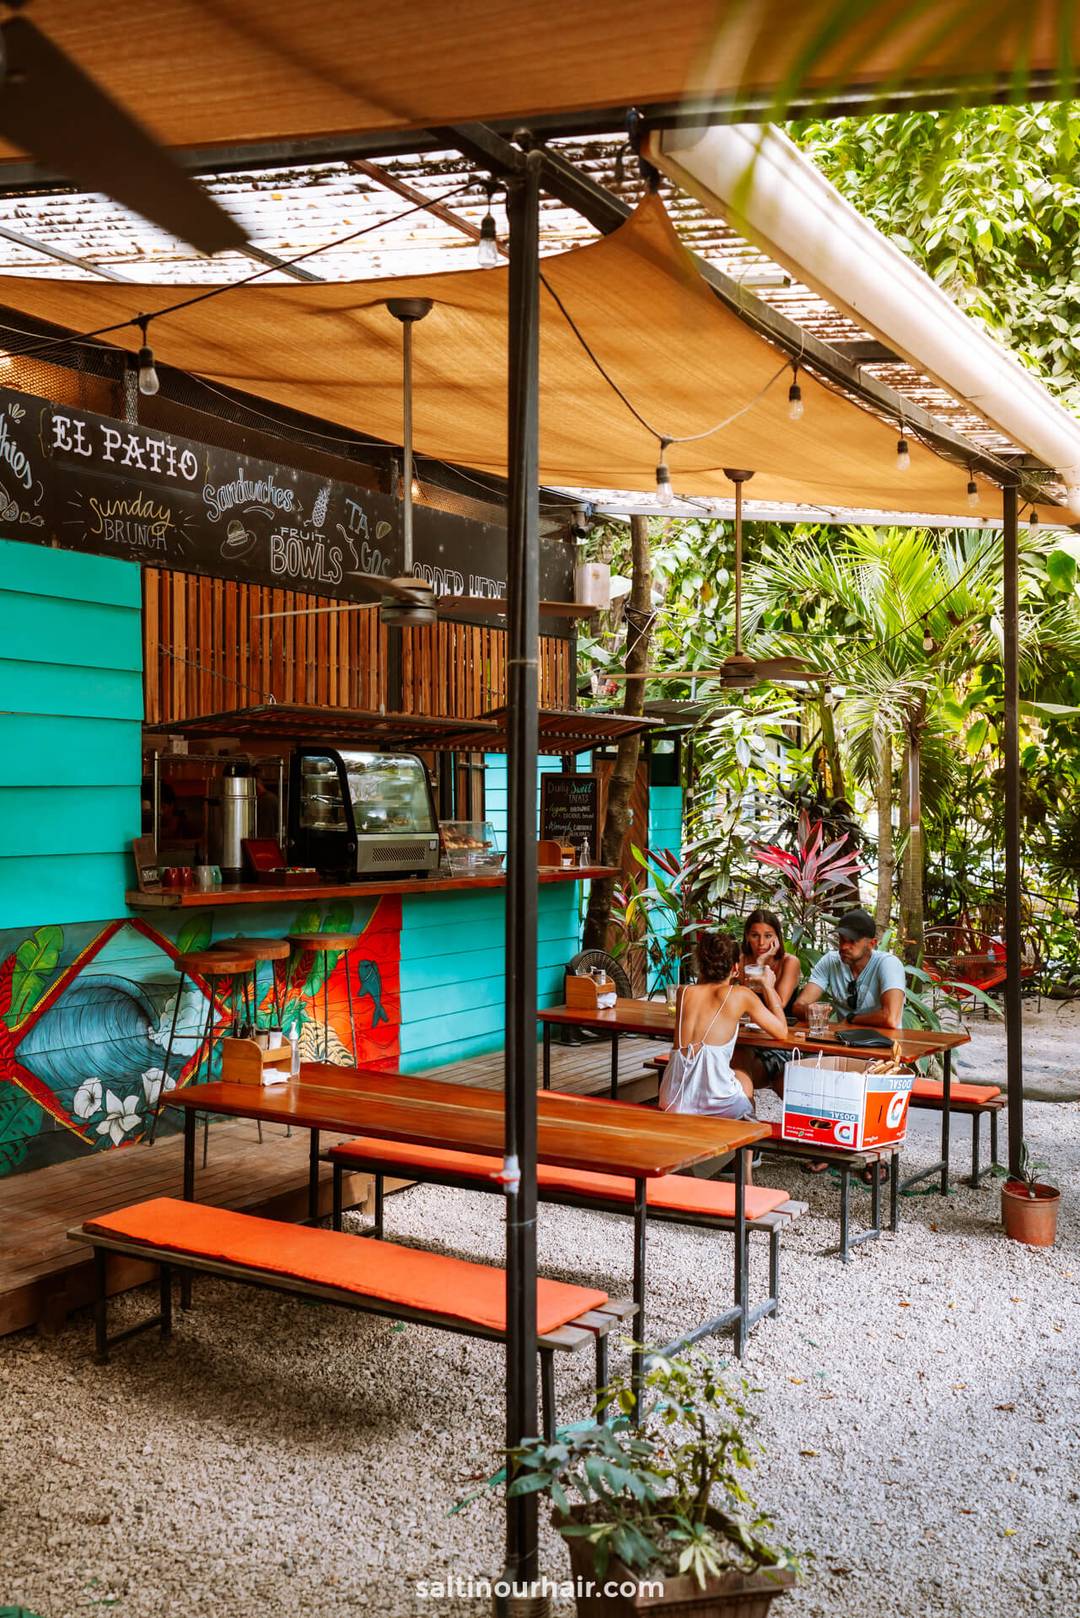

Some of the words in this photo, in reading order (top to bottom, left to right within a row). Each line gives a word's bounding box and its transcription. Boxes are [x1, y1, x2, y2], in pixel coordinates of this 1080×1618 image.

[0, 413, 33, 490] thies
[51, 415, 93, 456] EL
[99, 424, 198, 480] PATIO
[89, 491, 175, 536] Sunday
[203, 468, 295, 523] Sandwiches
[103, 519, 168, 551] BRUNCH
[280, 526, 326, 542] FRUIT
[270, 535, 344, 585] BOWLS
[890, 1079, 912, 1090] DOSAL
[830, 1111, 856, 1122] DOSAL
